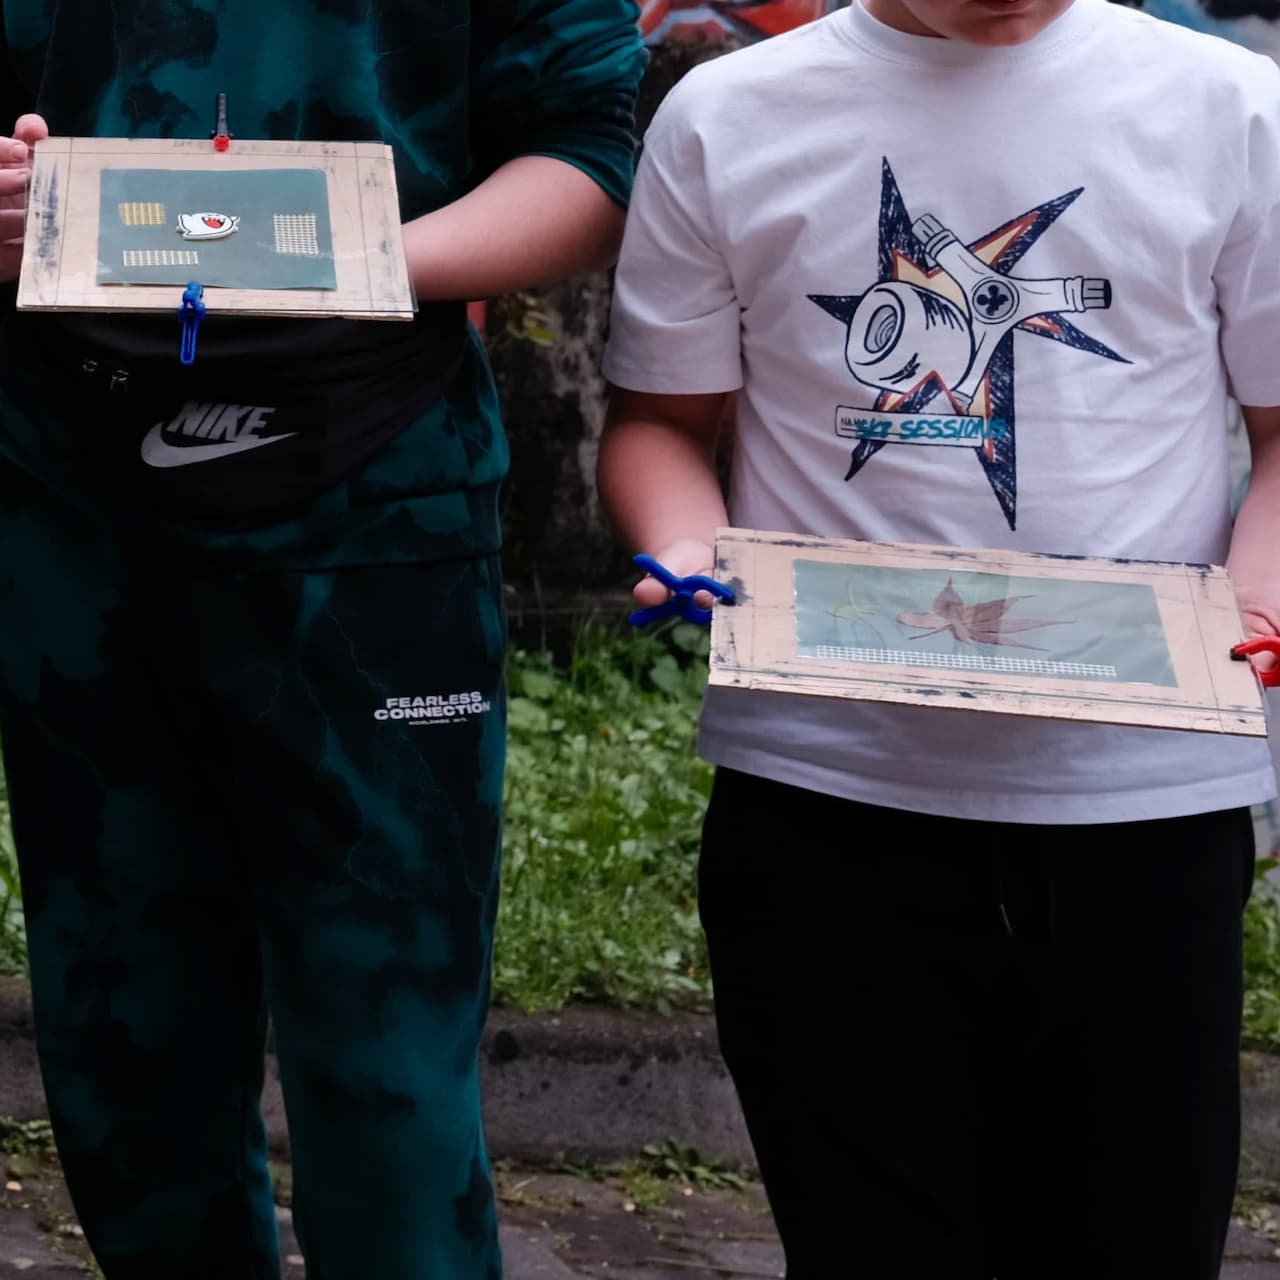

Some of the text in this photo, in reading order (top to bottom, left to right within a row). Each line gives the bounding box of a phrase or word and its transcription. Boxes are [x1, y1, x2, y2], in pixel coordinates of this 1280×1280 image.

[165, 401, 276, 442] NIKE
[900, 418, 1008, 440] SESSIONS
[374, 700, 491, 720] CONNECTION
[386, 691, 482, 709] FEARLESS
